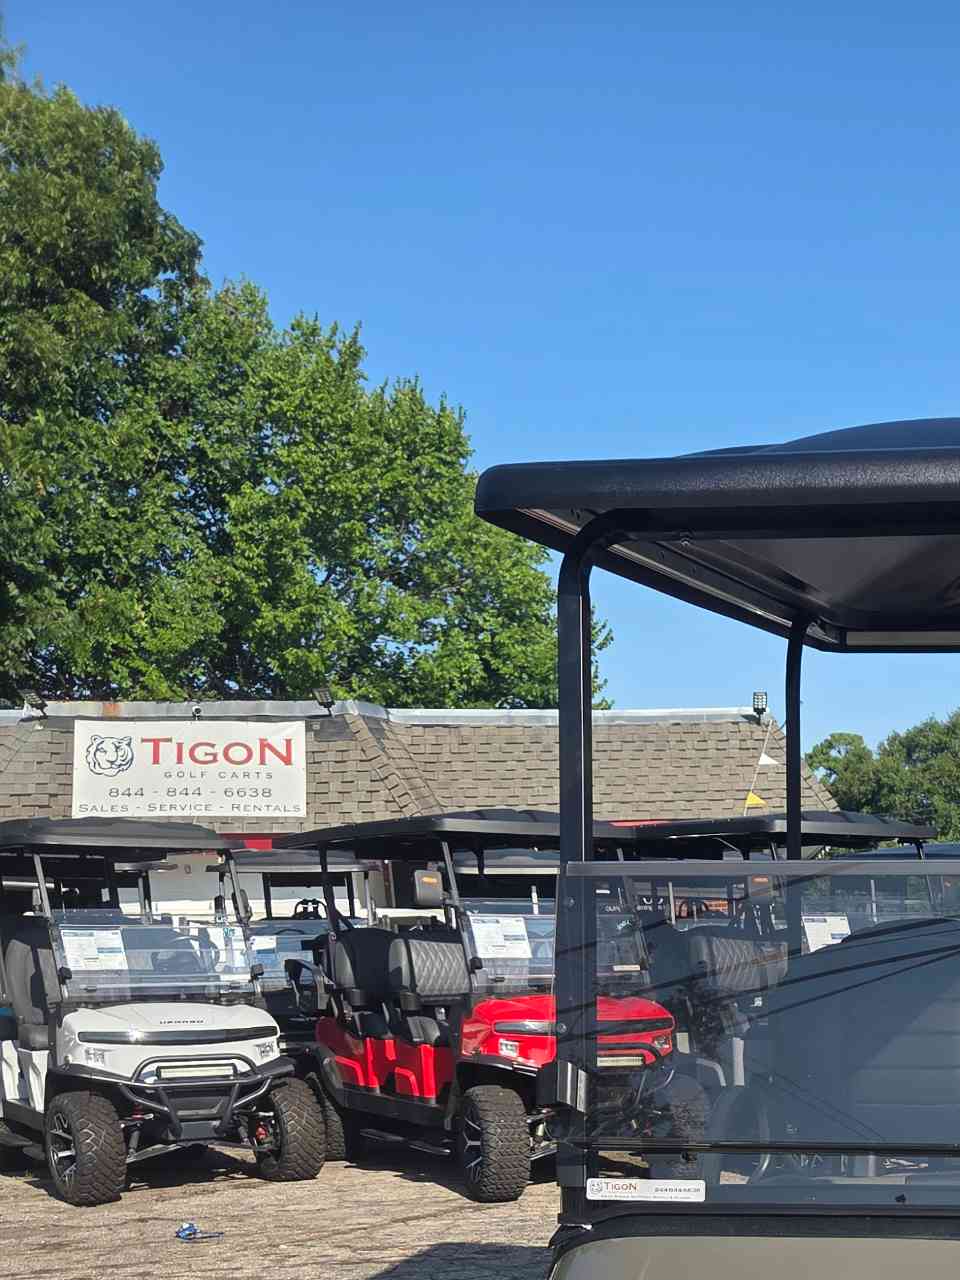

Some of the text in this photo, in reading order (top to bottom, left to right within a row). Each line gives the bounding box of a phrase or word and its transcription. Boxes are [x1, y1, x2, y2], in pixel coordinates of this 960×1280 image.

[140, 737, 293, 766] TIGON
[163, 770, 273, 780] GOLF CARTS
[108, 787, 145, 798] 844
[166, 786, 202, 797] 844
[223, 787, 272, 798] 6638
